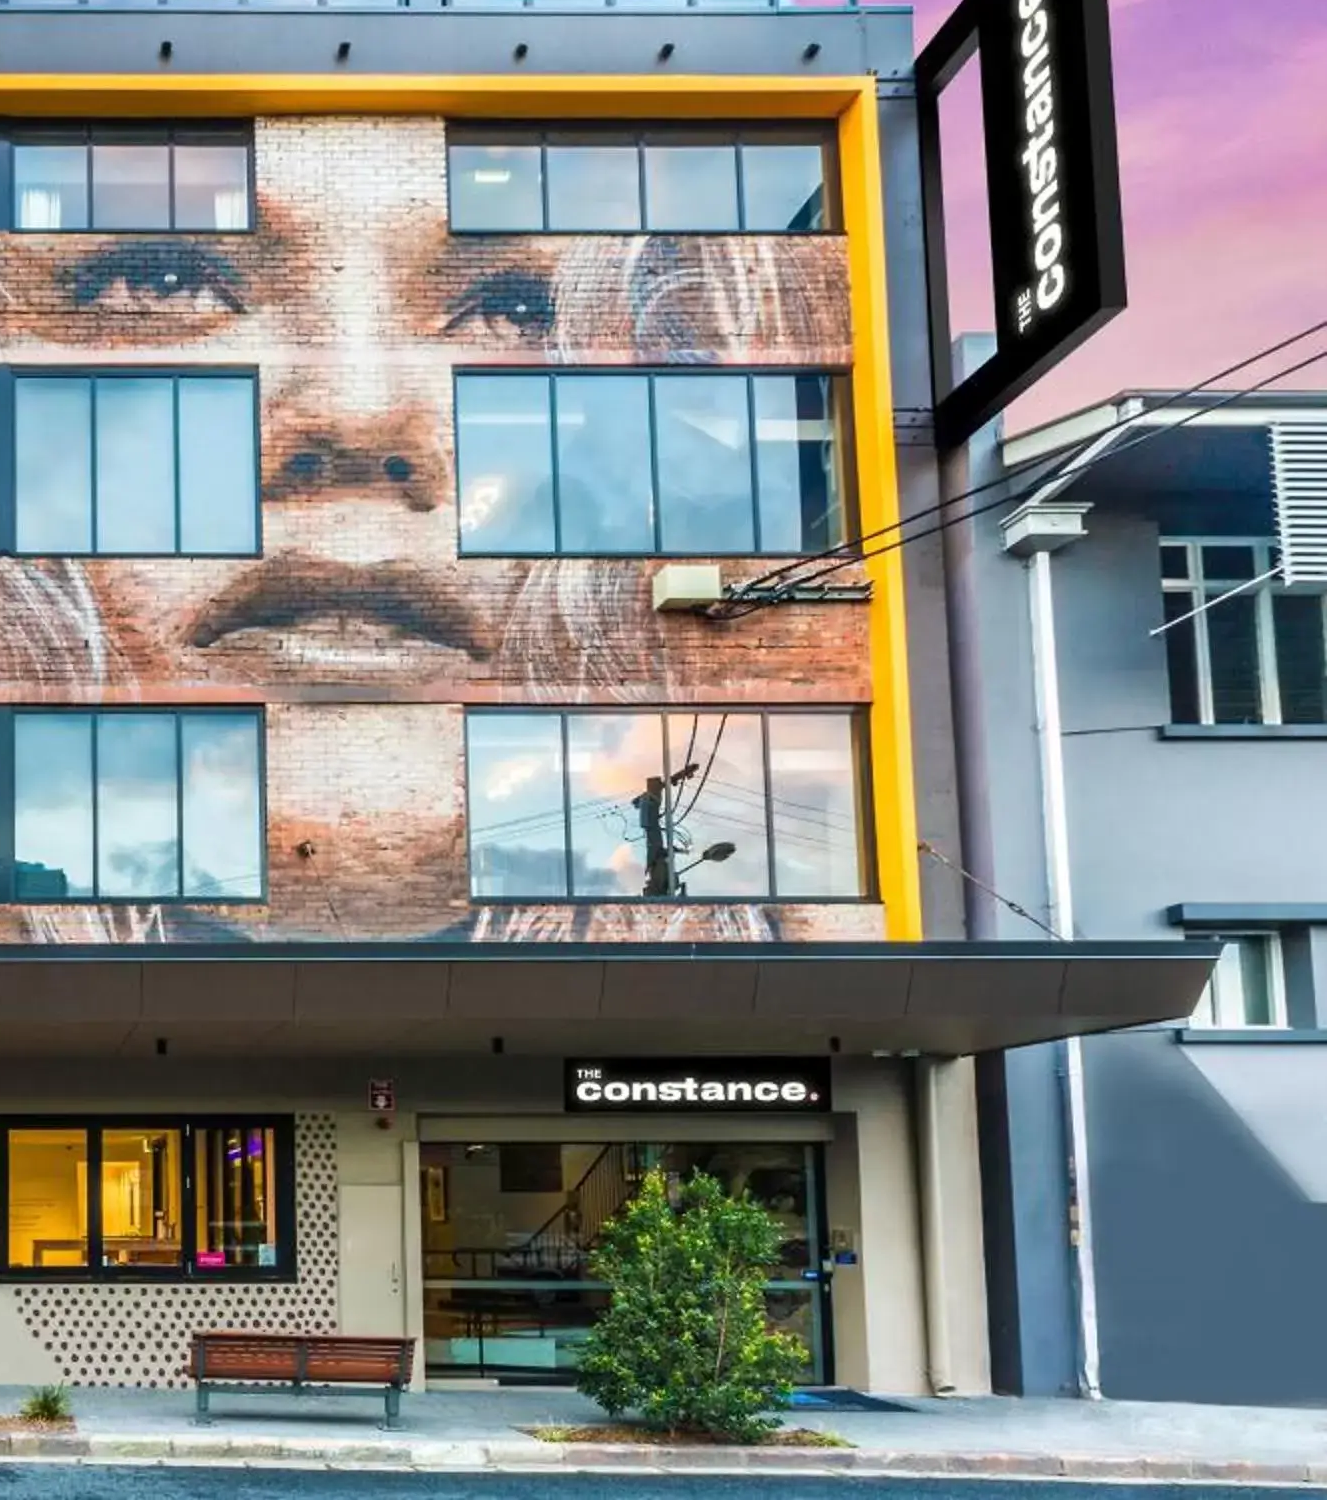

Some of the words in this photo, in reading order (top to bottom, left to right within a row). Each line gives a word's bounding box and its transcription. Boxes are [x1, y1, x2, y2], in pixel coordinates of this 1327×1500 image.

[1017, 288, 1032, 334] THE
[577, 1069, 602, 1079] THE
[576, 1077, 820, 1102] constance.
